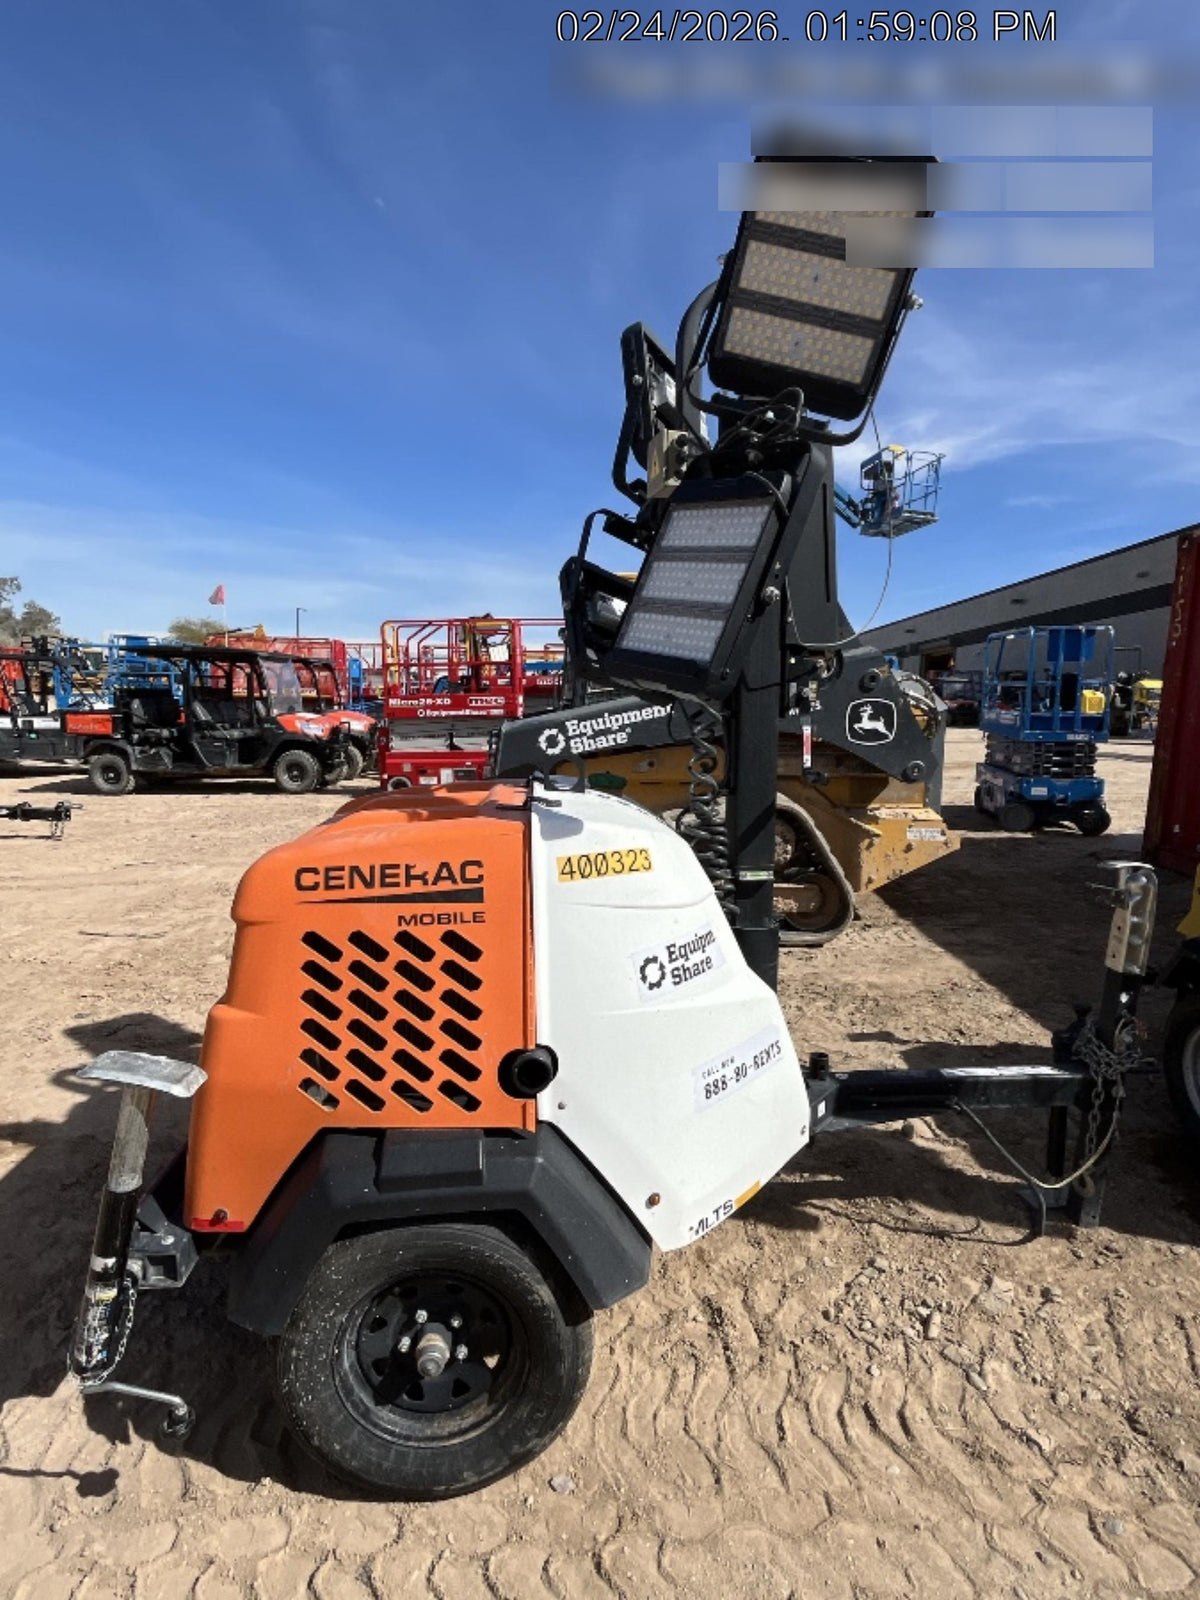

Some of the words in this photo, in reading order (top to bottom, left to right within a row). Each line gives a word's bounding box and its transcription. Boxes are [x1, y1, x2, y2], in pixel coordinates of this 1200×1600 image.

[560, 849, 652, 880] 400323
[397, 911, 486, 927] MOBILE
[670, 956, 713, 986] Share
